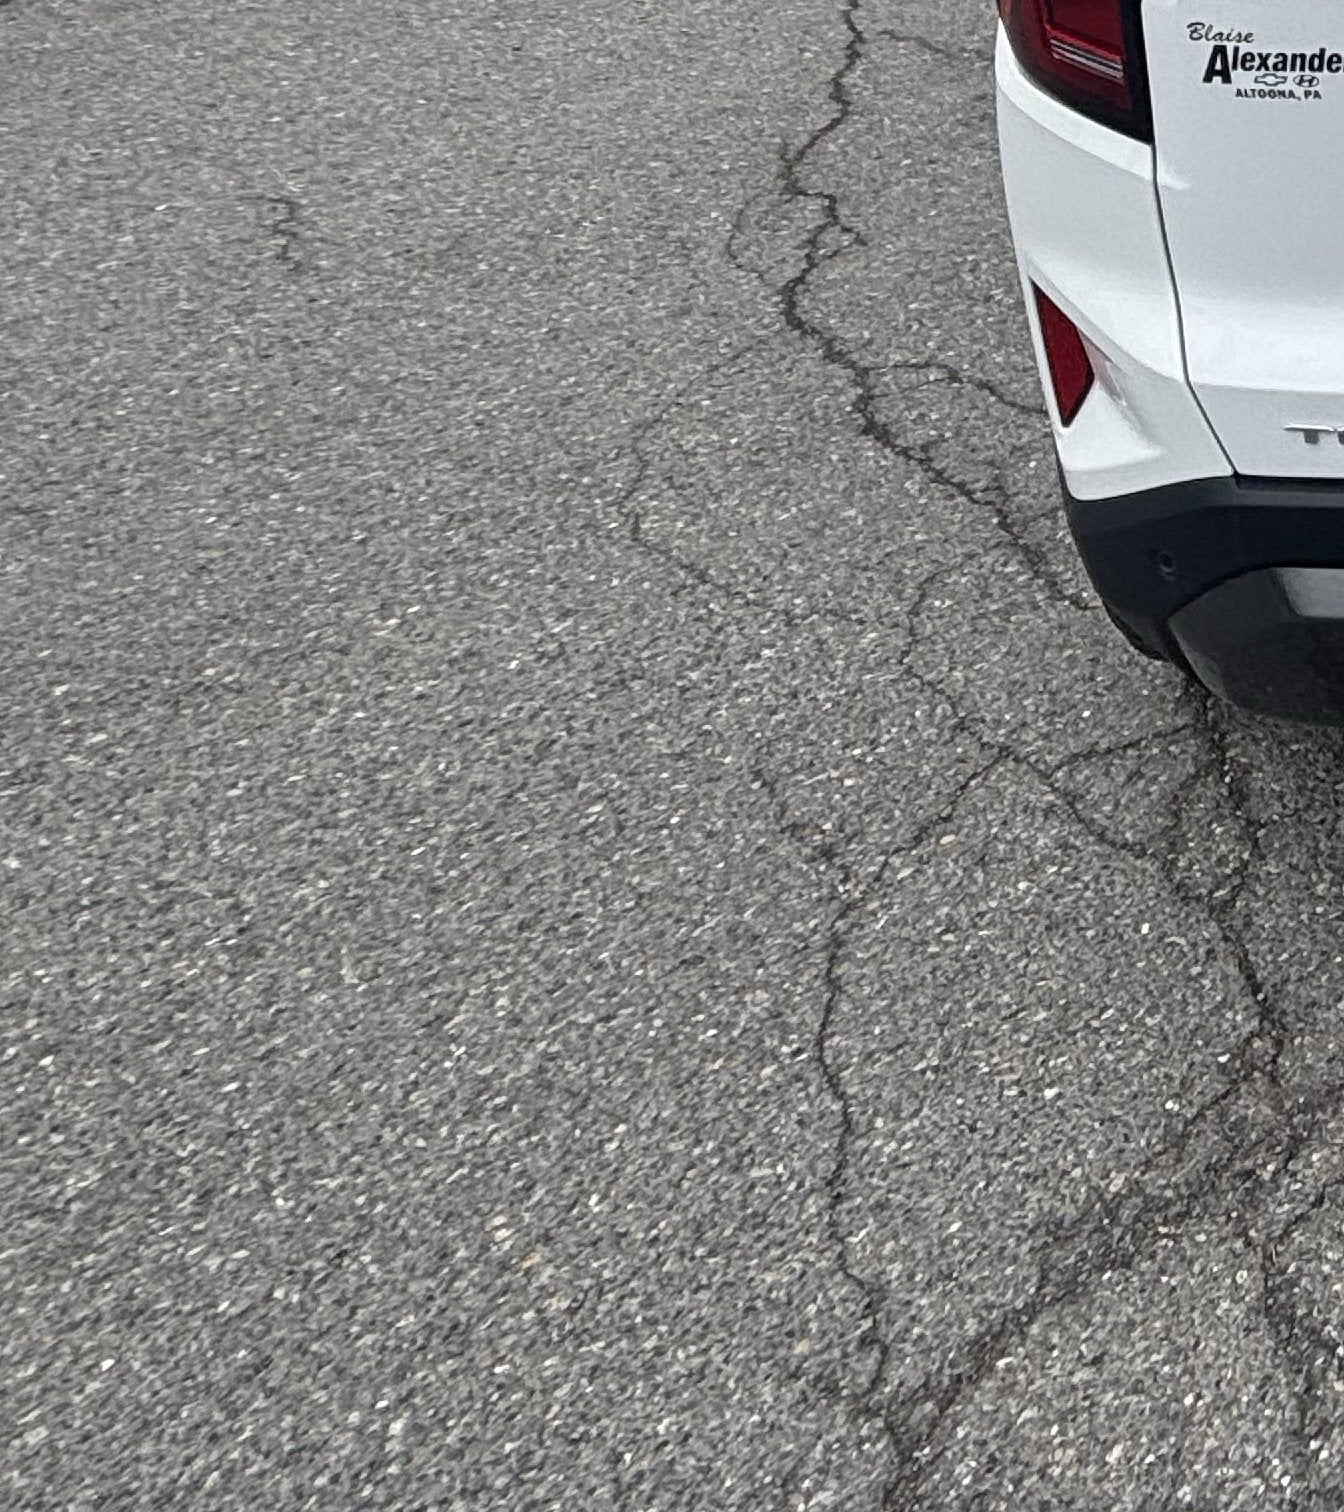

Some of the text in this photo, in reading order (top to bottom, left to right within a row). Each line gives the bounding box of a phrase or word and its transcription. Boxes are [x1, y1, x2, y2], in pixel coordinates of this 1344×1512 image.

[1186, 21, 1255, 44] Blaise
[1235, 88, 1323, 101] ALTOONA, PA
